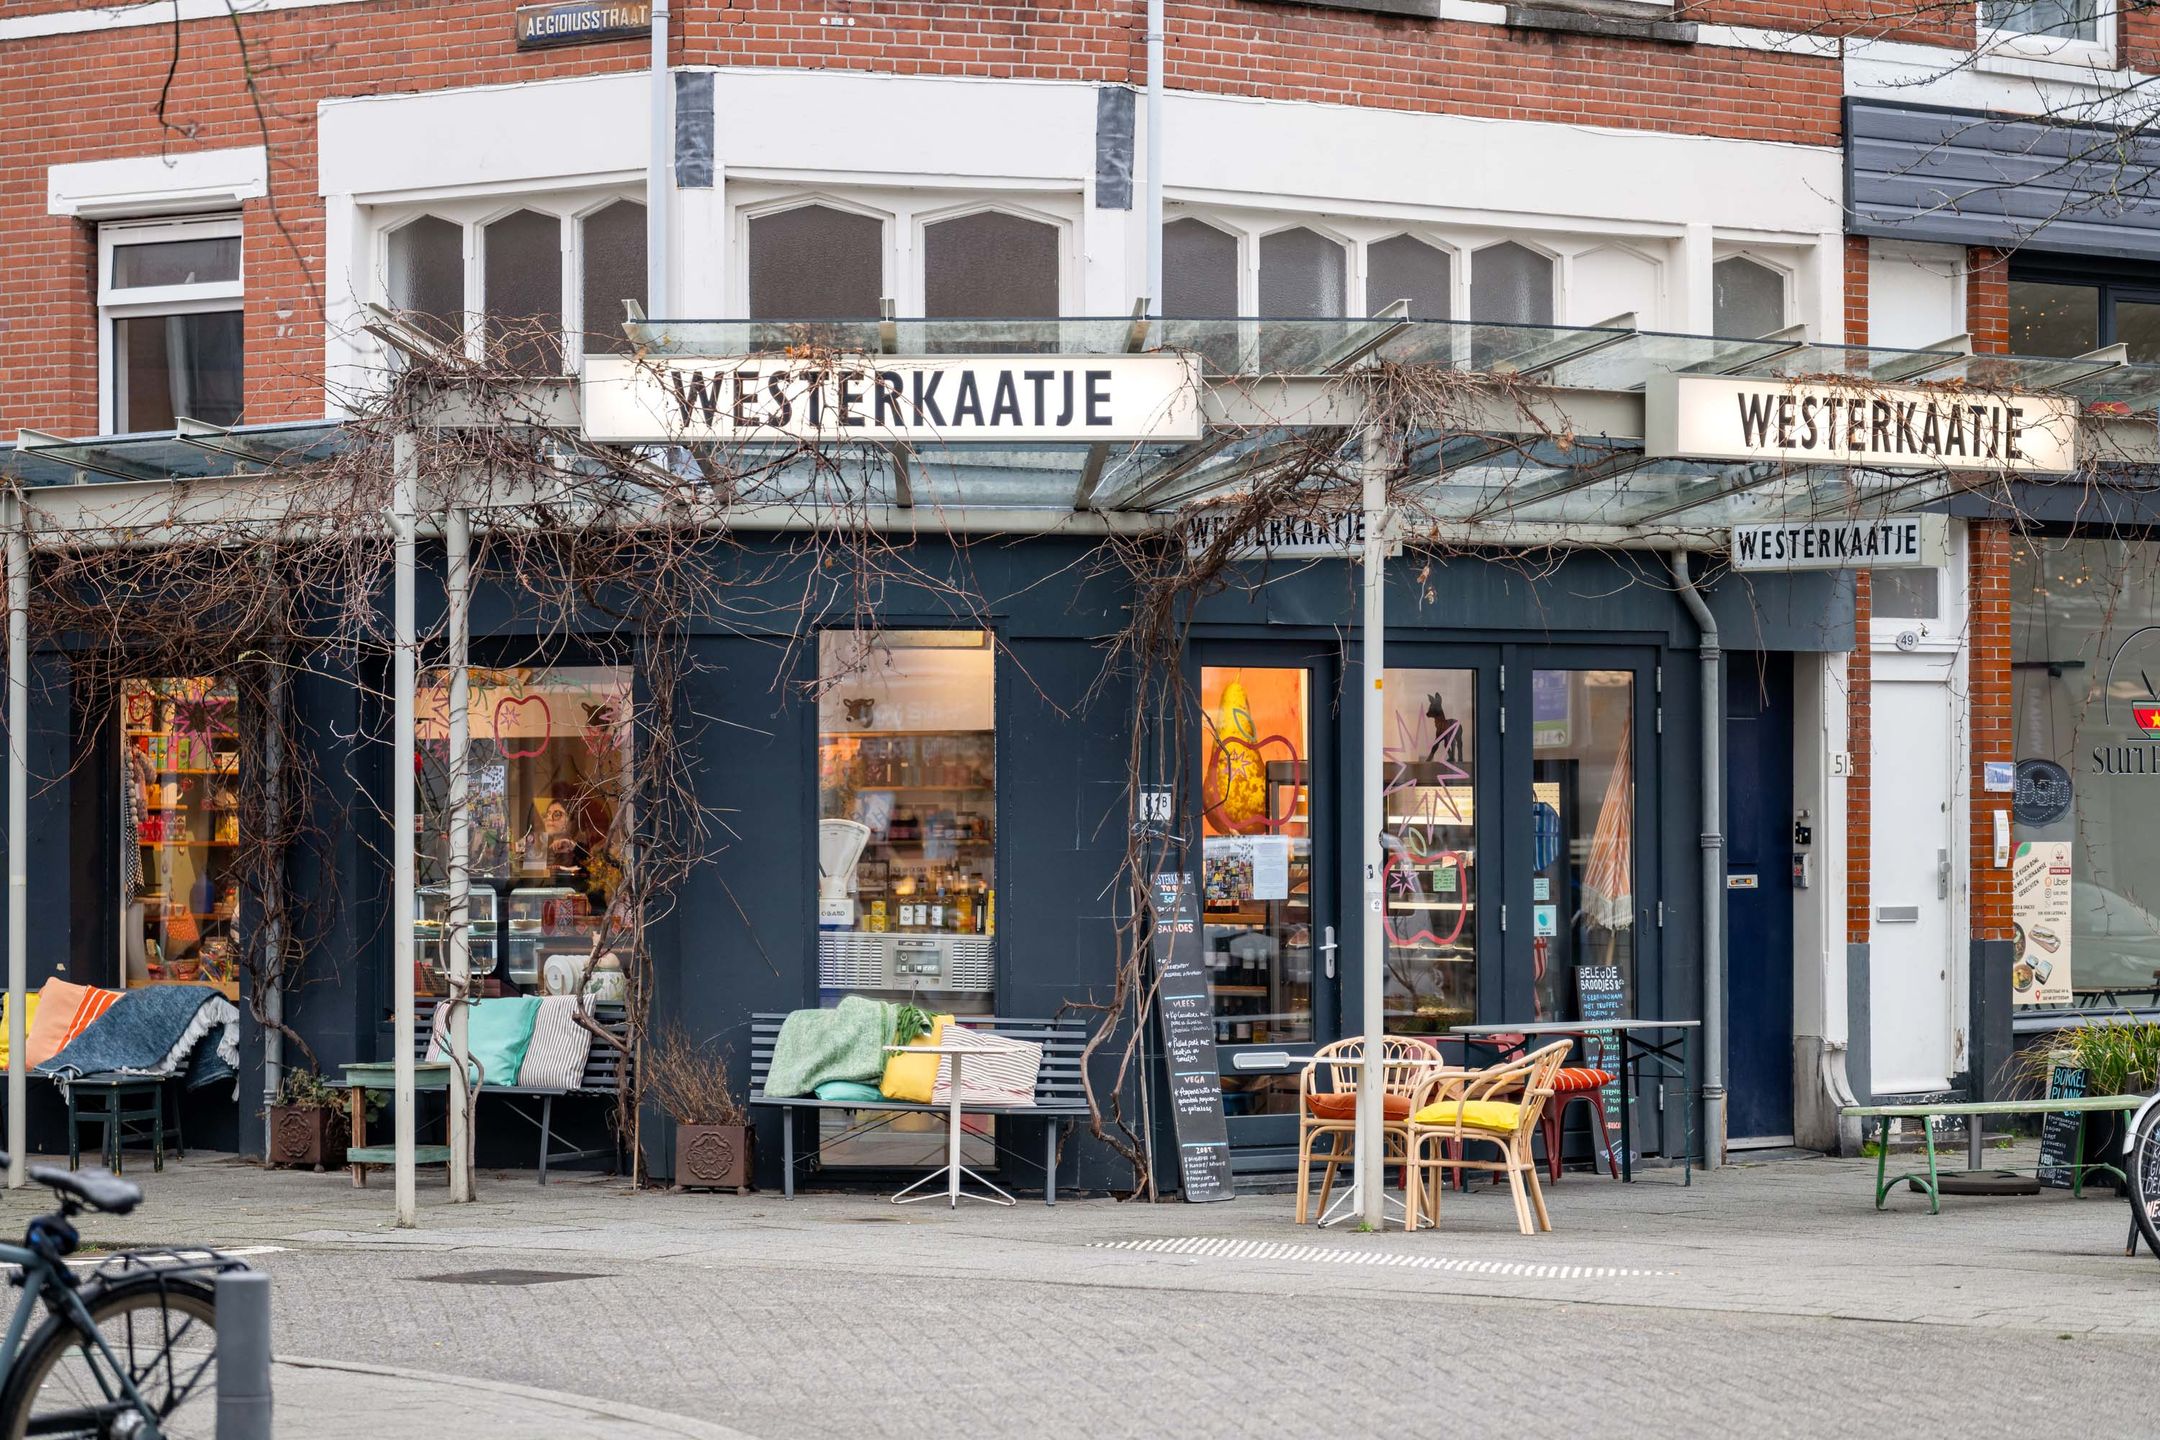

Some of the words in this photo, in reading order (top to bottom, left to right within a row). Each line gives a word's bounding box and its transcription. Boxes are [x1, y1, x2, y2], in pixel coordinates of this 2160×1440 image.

[526, 5, 648, 37] AEGIDIUSSTRAAT
[671, 369, 1114, 428] WESTERKAATJE
[1737, 392, 2024, 460] WESTERKAATJE
[1738, 524, 1917, 561] WESTERKAATJE
[1901, 635, 1913, 646] 49
[1834, 755, 1847, 774] 51
[1580, 966, 1618, 979] BELEGDE
[1581, 979, 1614, 992] BROODJES
[1172, 999, 1196, 1008] VLEES
[1183, 1075, 1205, 1084] VEGA
